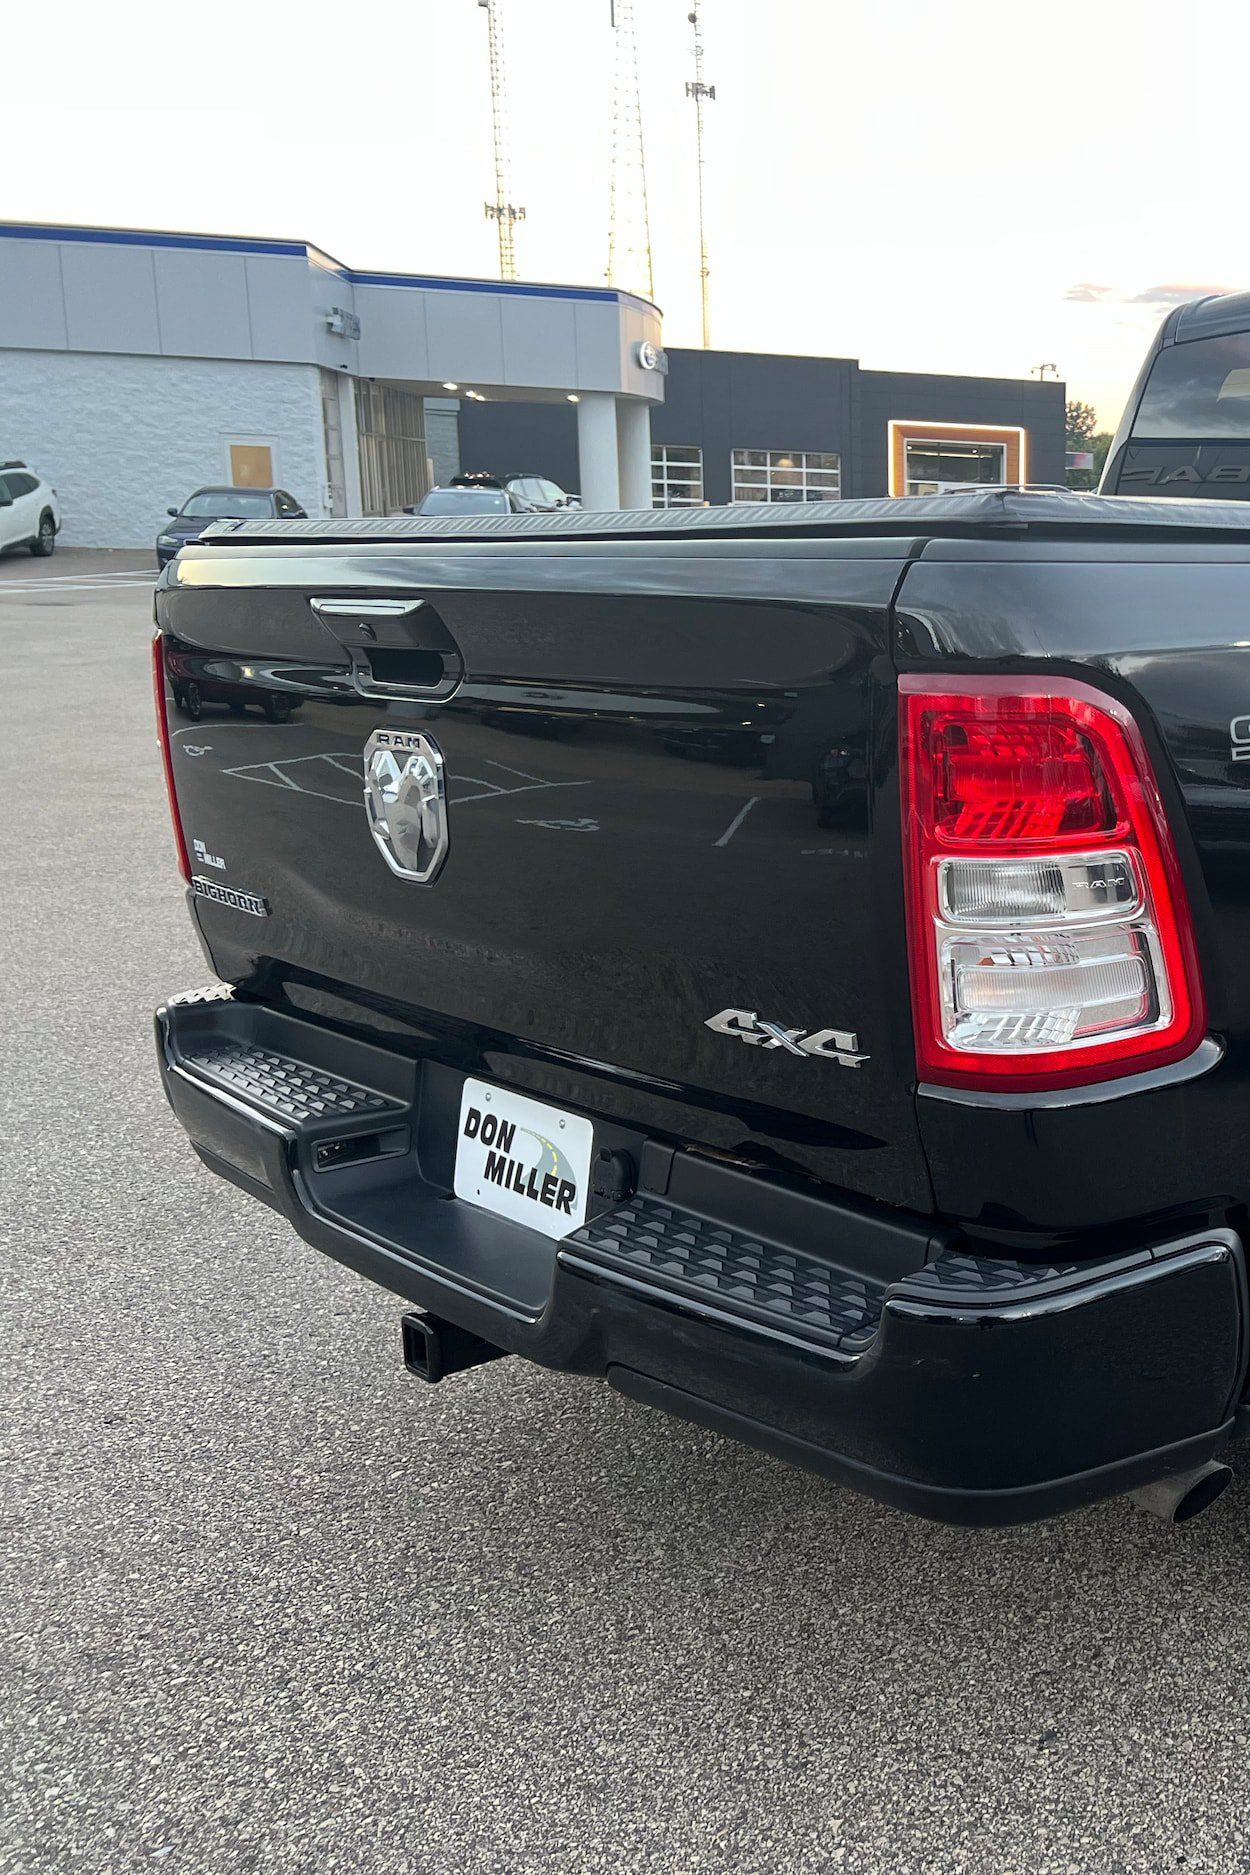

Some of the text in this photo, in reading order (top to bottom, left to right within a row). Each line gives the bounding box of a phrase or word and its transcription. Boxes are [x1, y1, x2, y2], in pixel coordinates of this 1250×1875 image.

[376, 734, 421, 749] RAM
[194, 880, 262, 915] BIGHORN
[1072, 878, 1125, 889] RAM
[463, 1106, 517, 1154] DON
[483, 1150, 577, 1217] MILLER
